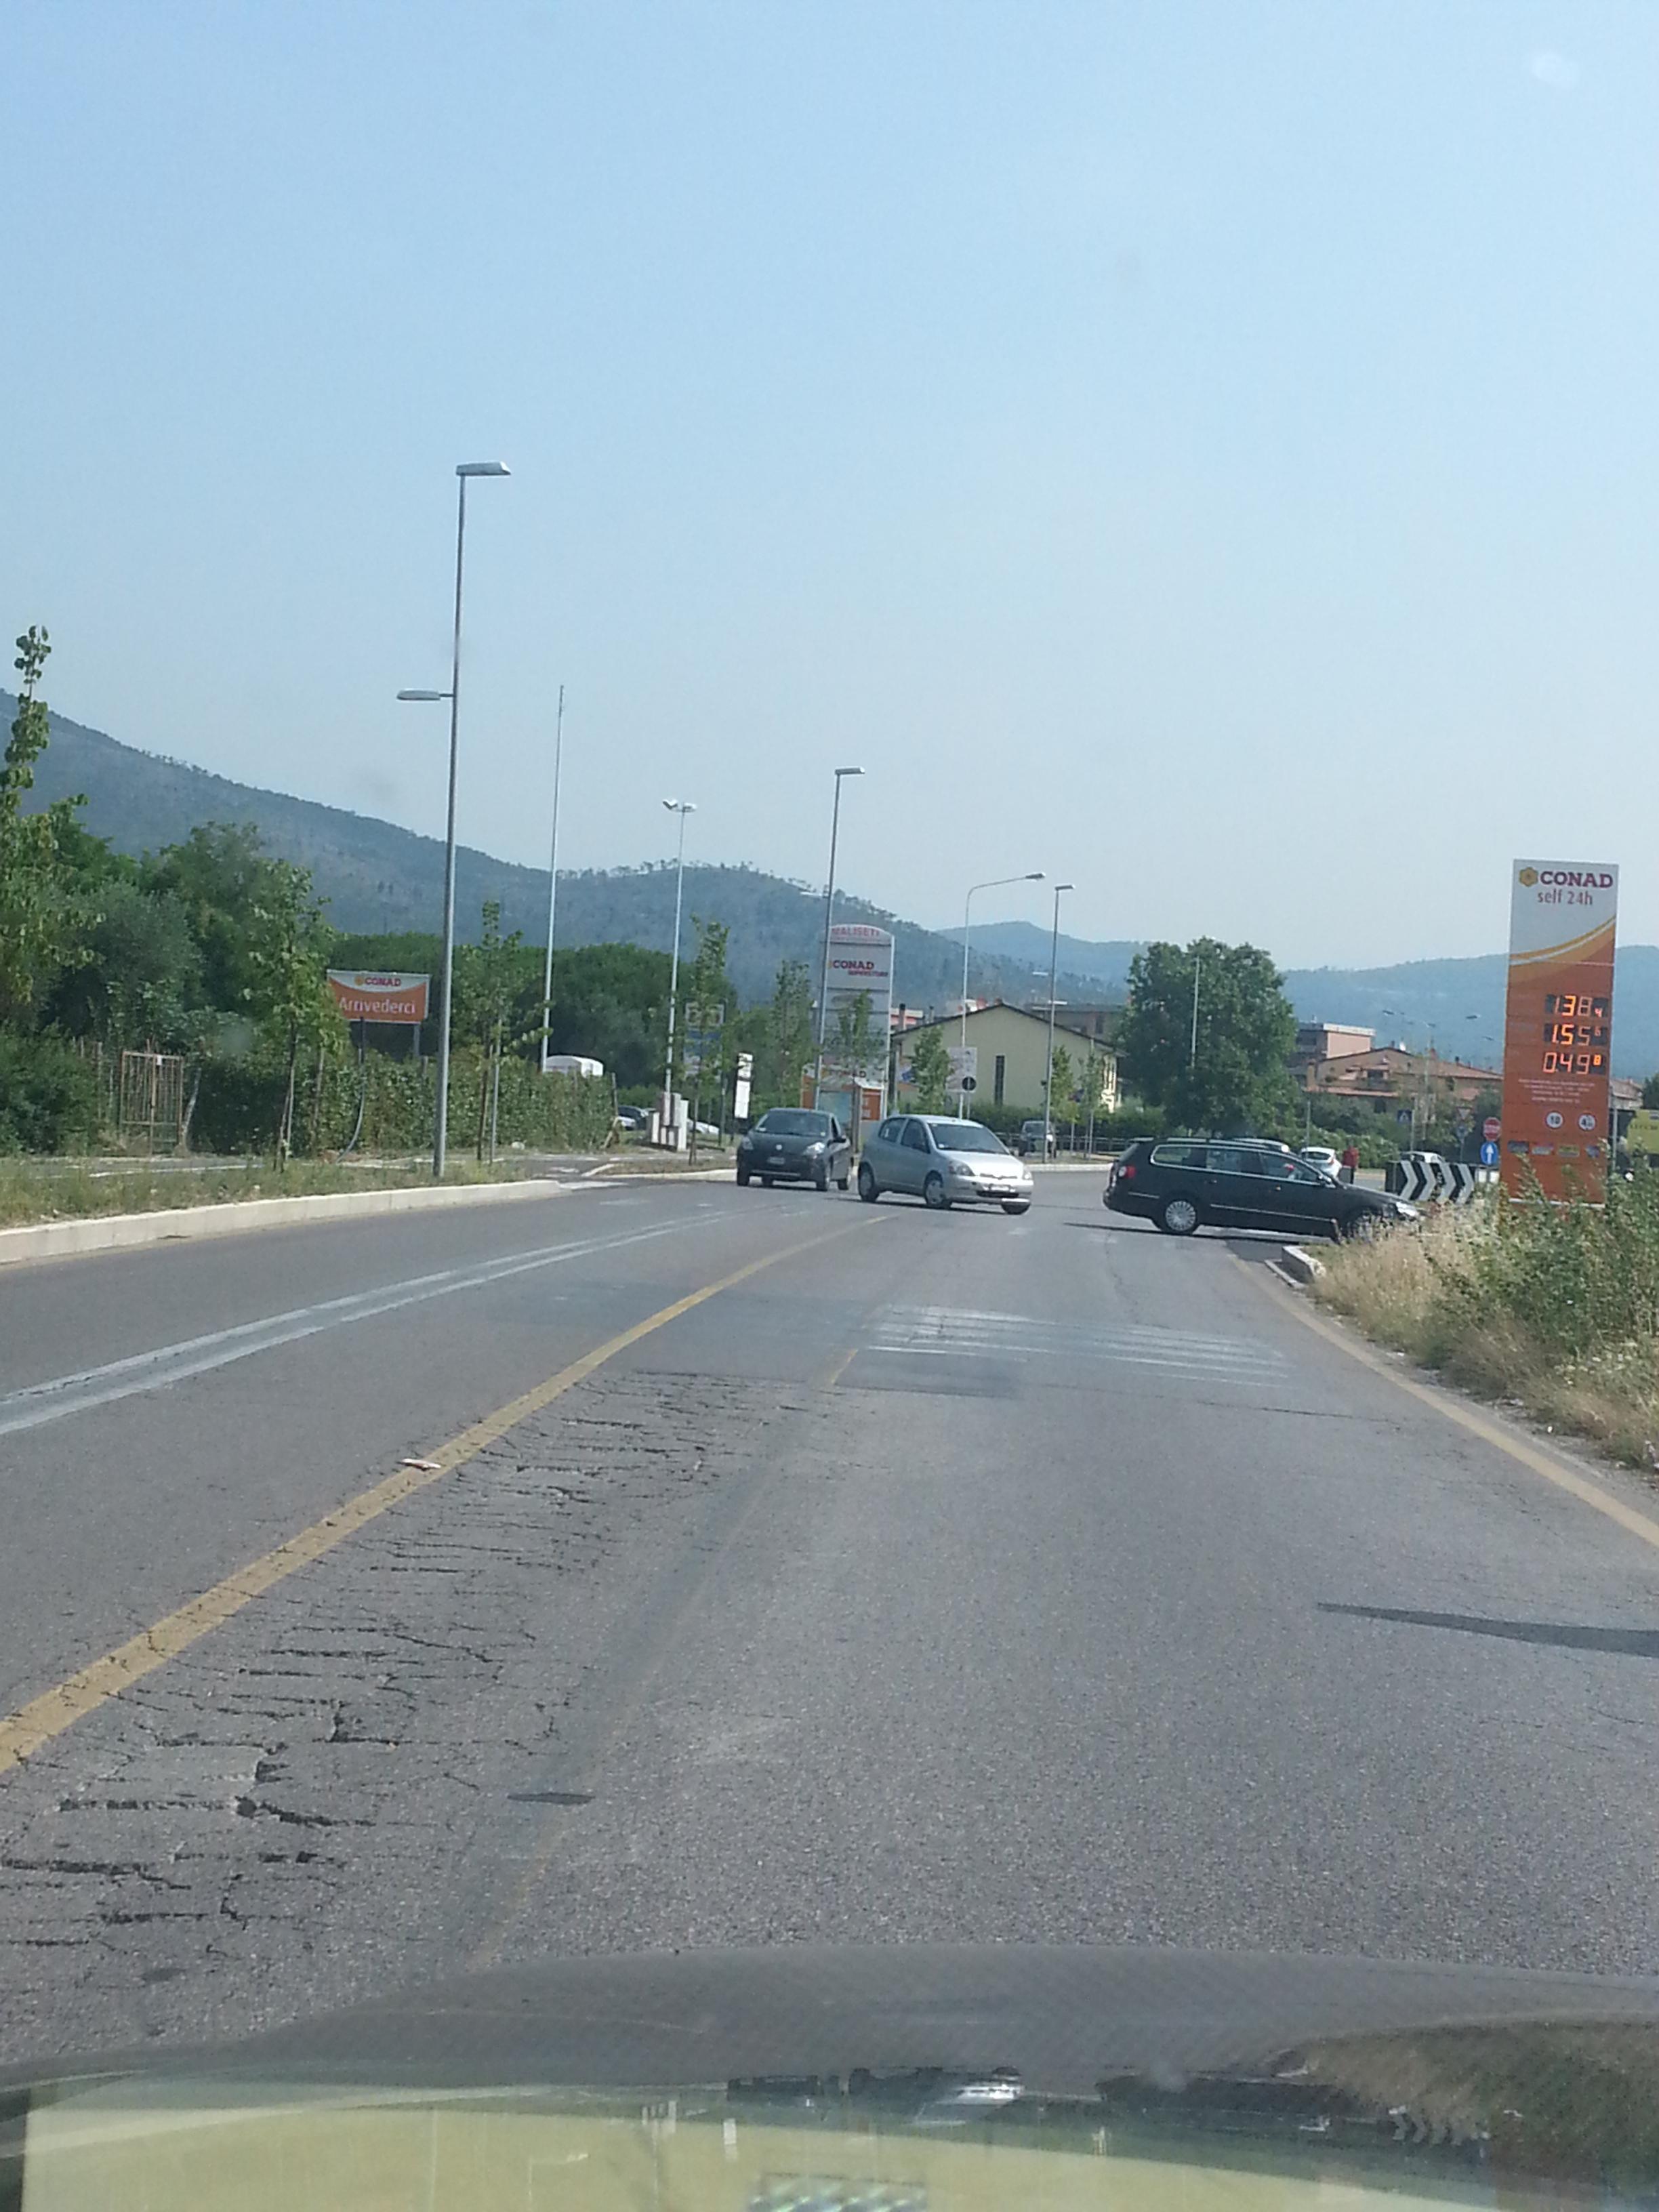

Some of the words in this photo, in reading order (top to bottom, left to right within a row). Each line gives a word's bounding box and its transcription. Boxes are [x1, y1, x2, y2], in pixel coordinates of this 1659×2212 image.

[1540, 870, 1614, 888] CONAD
[1537, 888, 1563, 903] self
[1567, 891, 1593, 905] 24h
[832, 960, 875, 970] CONAD
[339, 996, 415, 1015] Arrivederci
